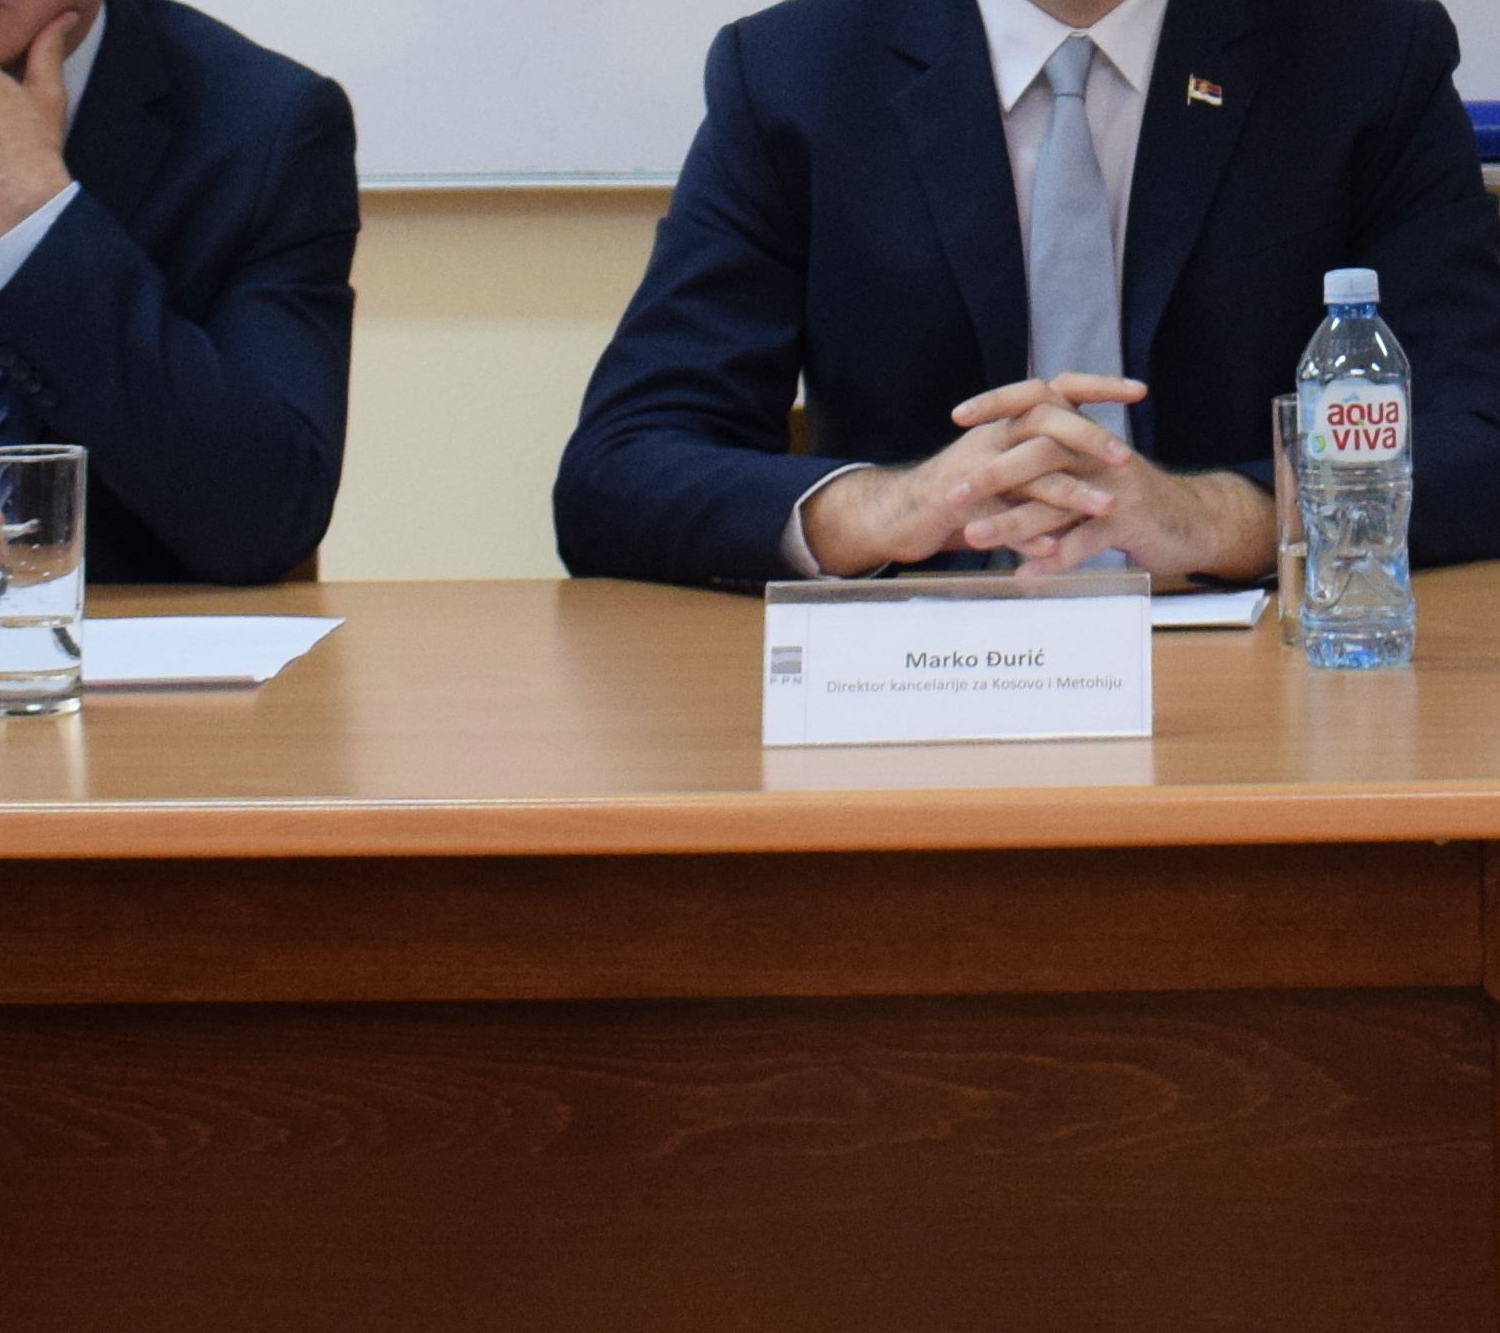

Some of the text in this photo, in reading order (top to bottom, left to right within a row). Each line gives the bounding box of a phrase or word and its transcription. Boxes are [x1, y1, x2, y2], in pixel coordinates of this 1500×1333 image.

[1327, 400, 1399, 426] aqua
[1332, 428, 1397, 451] viva
[905, 647, 1045, 669] Marko Đurić
[827, 679, 885, 693] Direktor
[890, 677, 968, 693] kancelarije
[972, 679, 987, 690] za
[992, 677, 1044, 690] Kosovo
[1056, 675, 1122, 692] Metohiju
